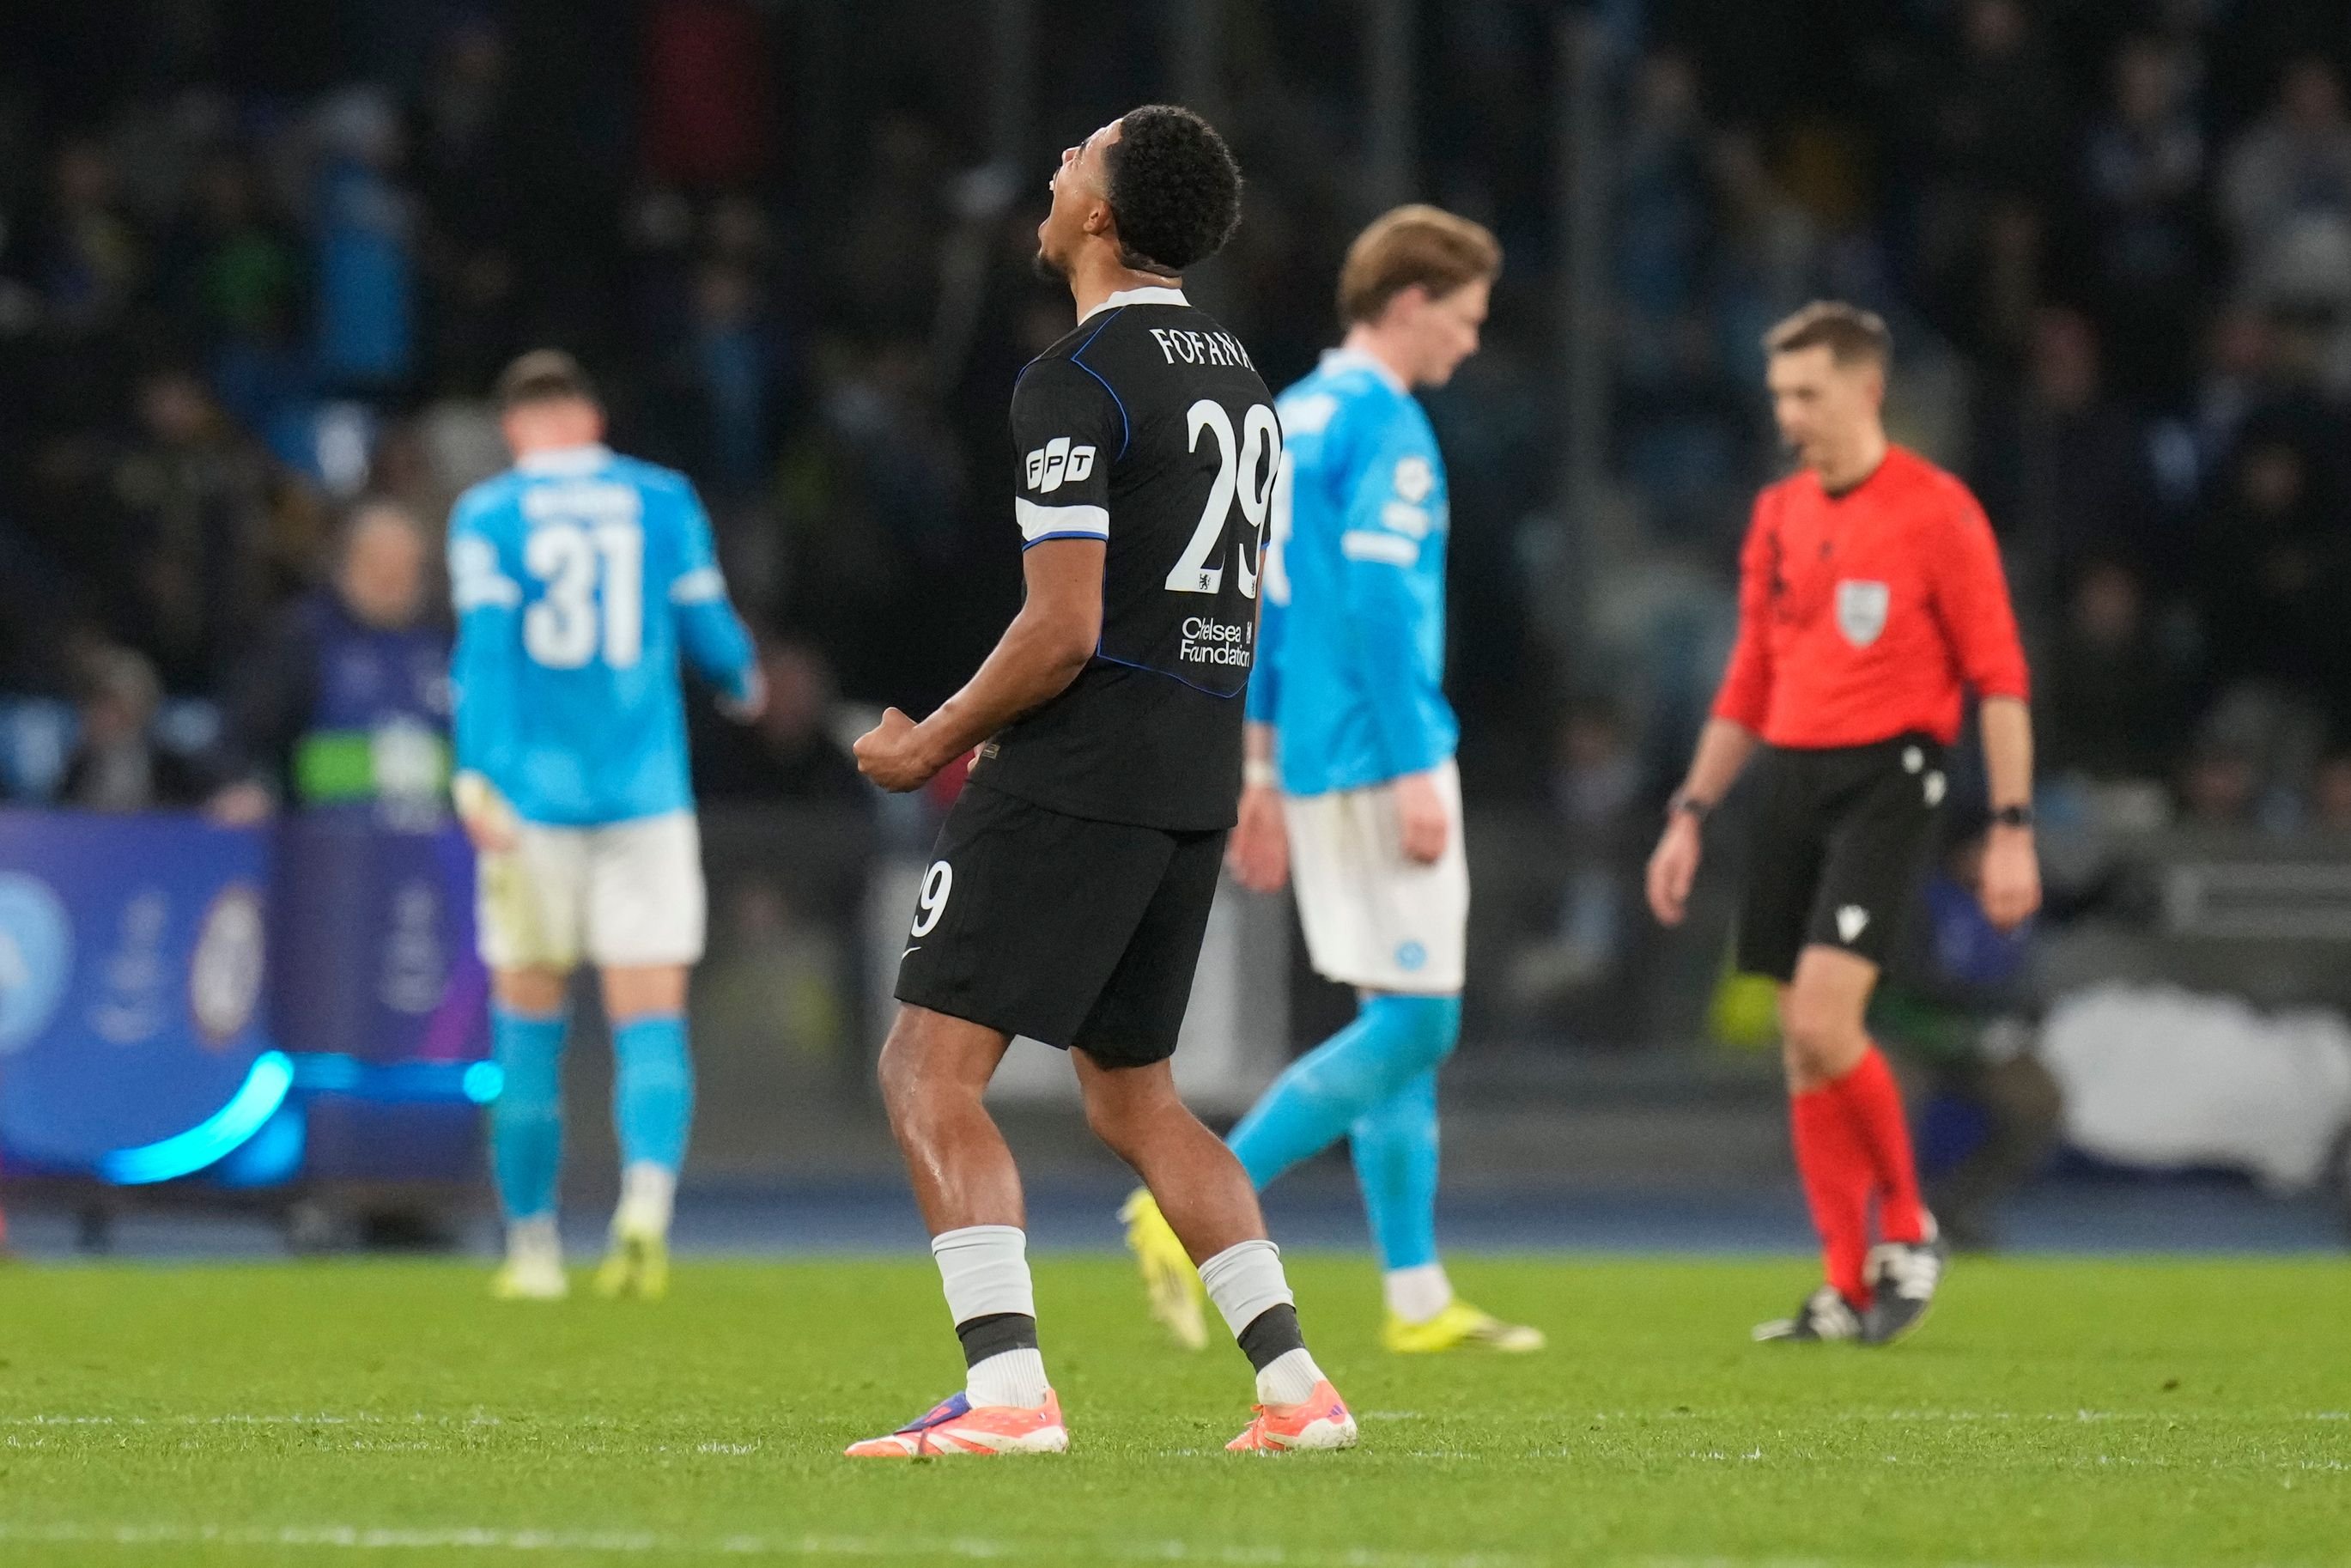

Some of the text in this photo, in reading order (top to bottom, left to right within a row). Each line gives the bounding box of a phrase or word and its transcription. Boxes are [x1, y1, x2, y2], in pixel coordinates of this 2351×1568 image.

[1149, 329, 1255, 372] FOFANA
[1164, 398, 1281, 599] 29
[522, 520, 643, 670] 31
[910, 860, 953, 938] 9
